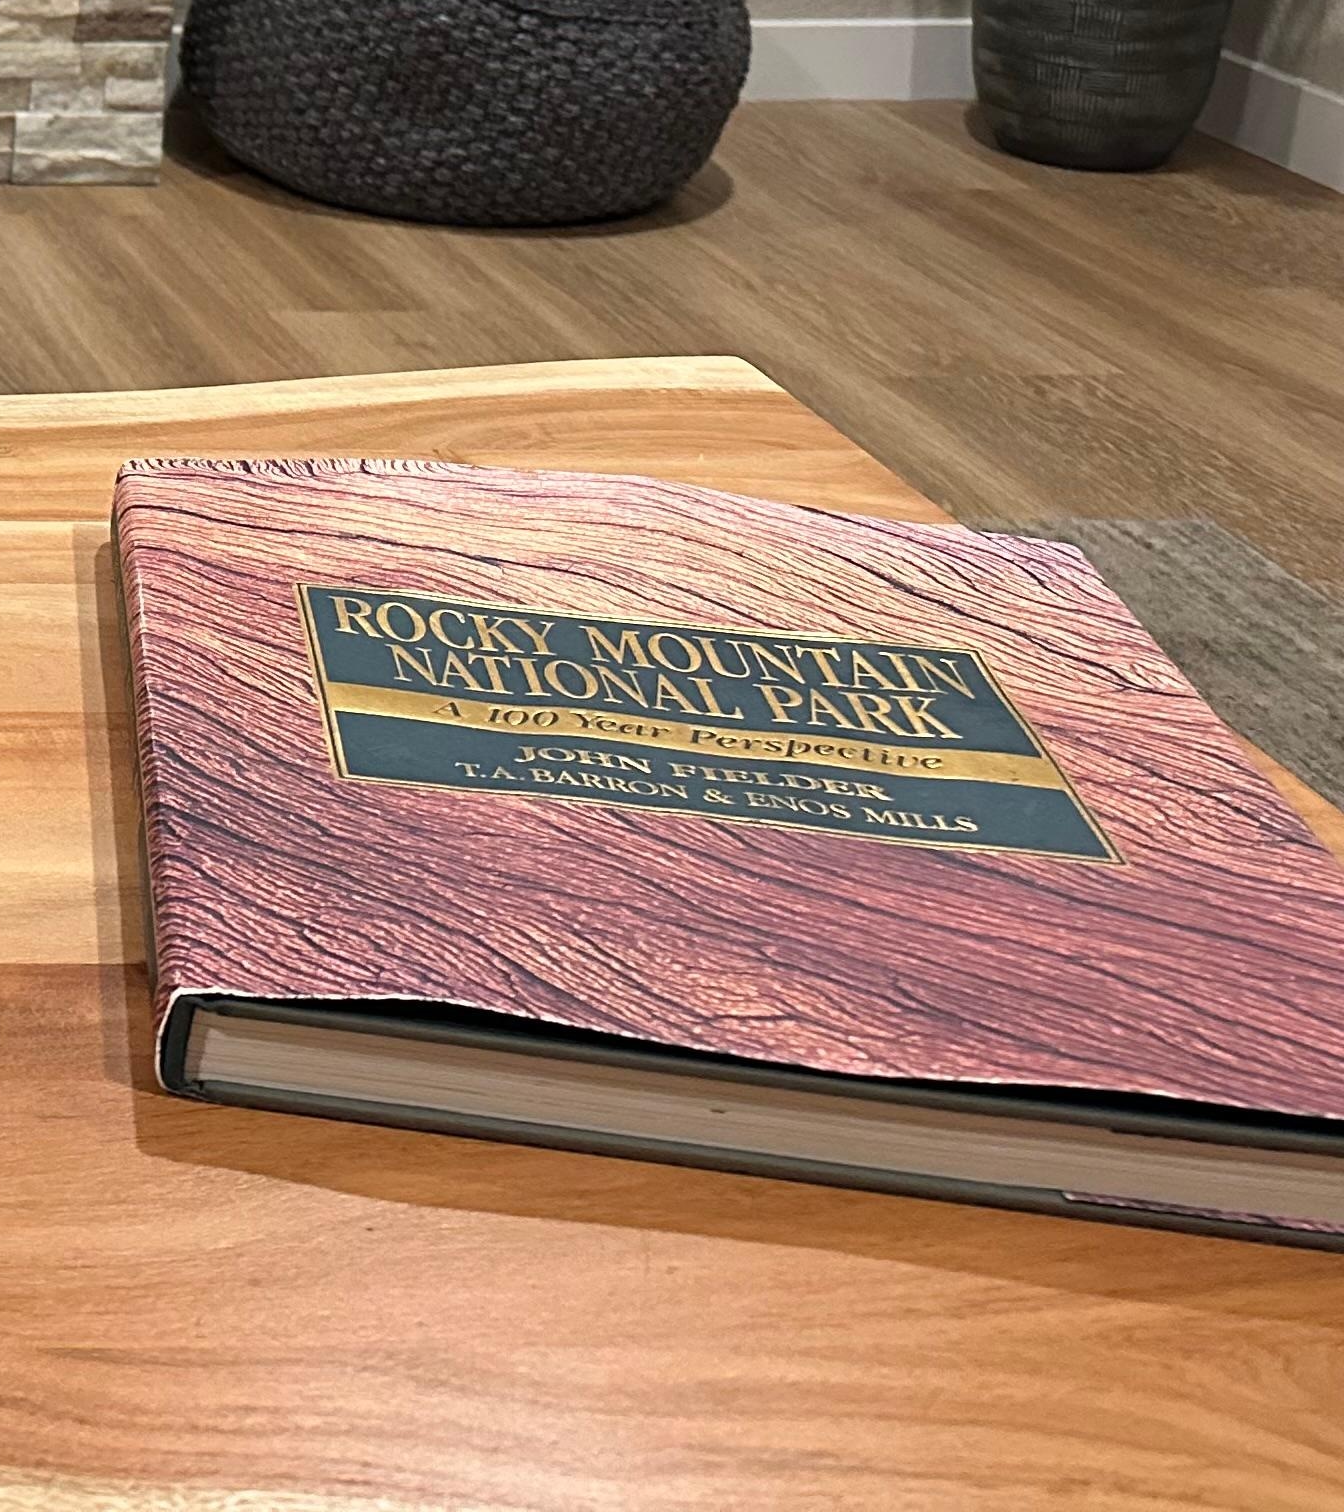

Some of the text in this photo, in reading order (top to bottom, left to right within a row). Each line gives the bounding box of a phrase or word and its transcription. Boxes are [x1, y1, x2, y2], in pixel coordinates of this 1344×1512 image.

[327, 595, 976, 700] ROCKY MOUNTAIN
[385, 643, 964, 739] NATIONAL PARK
[432, 700, 945, 770] A 100 Year Perspective
[514, 745, 895, 802] JOHN FIELDER
[529, 767, 688, 799] BARRON
[702, 787, 736, 805] &
[743, 790, 852, 820] ENOS
[861, 806, 980, 833] MILLS
